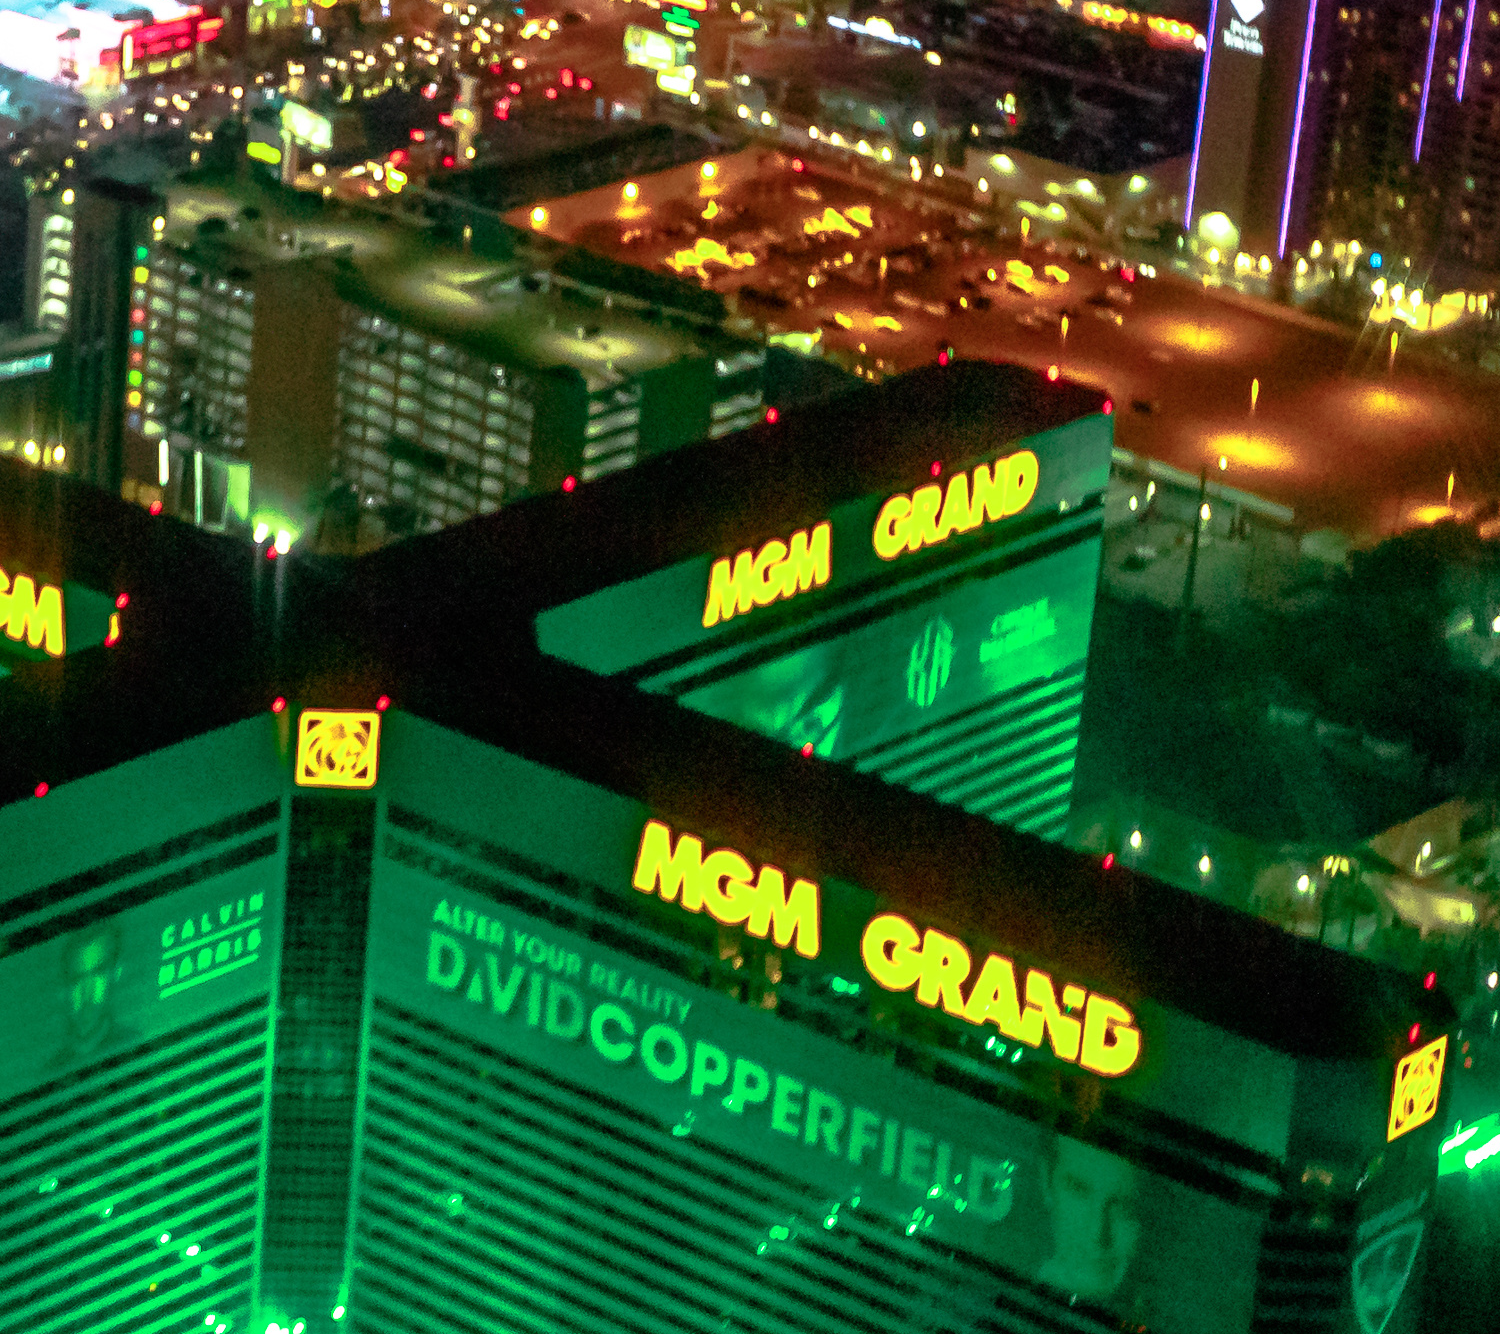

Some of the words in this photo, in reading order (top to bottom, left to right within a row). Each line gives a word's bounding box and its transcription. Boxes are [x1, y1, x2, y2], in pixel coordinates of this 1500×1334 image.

[701, 523, 831, 628] MGM
[873, 450, 1040, 559] GRAND
[161, 891, 265, 949] CALVIN
[513, 928, 583, 981] YOUR
[589, 961, 693, 1025] REALITY
[632, 821, 820, 959] MGM
[861, 914, 1141, 1076] GRAND
